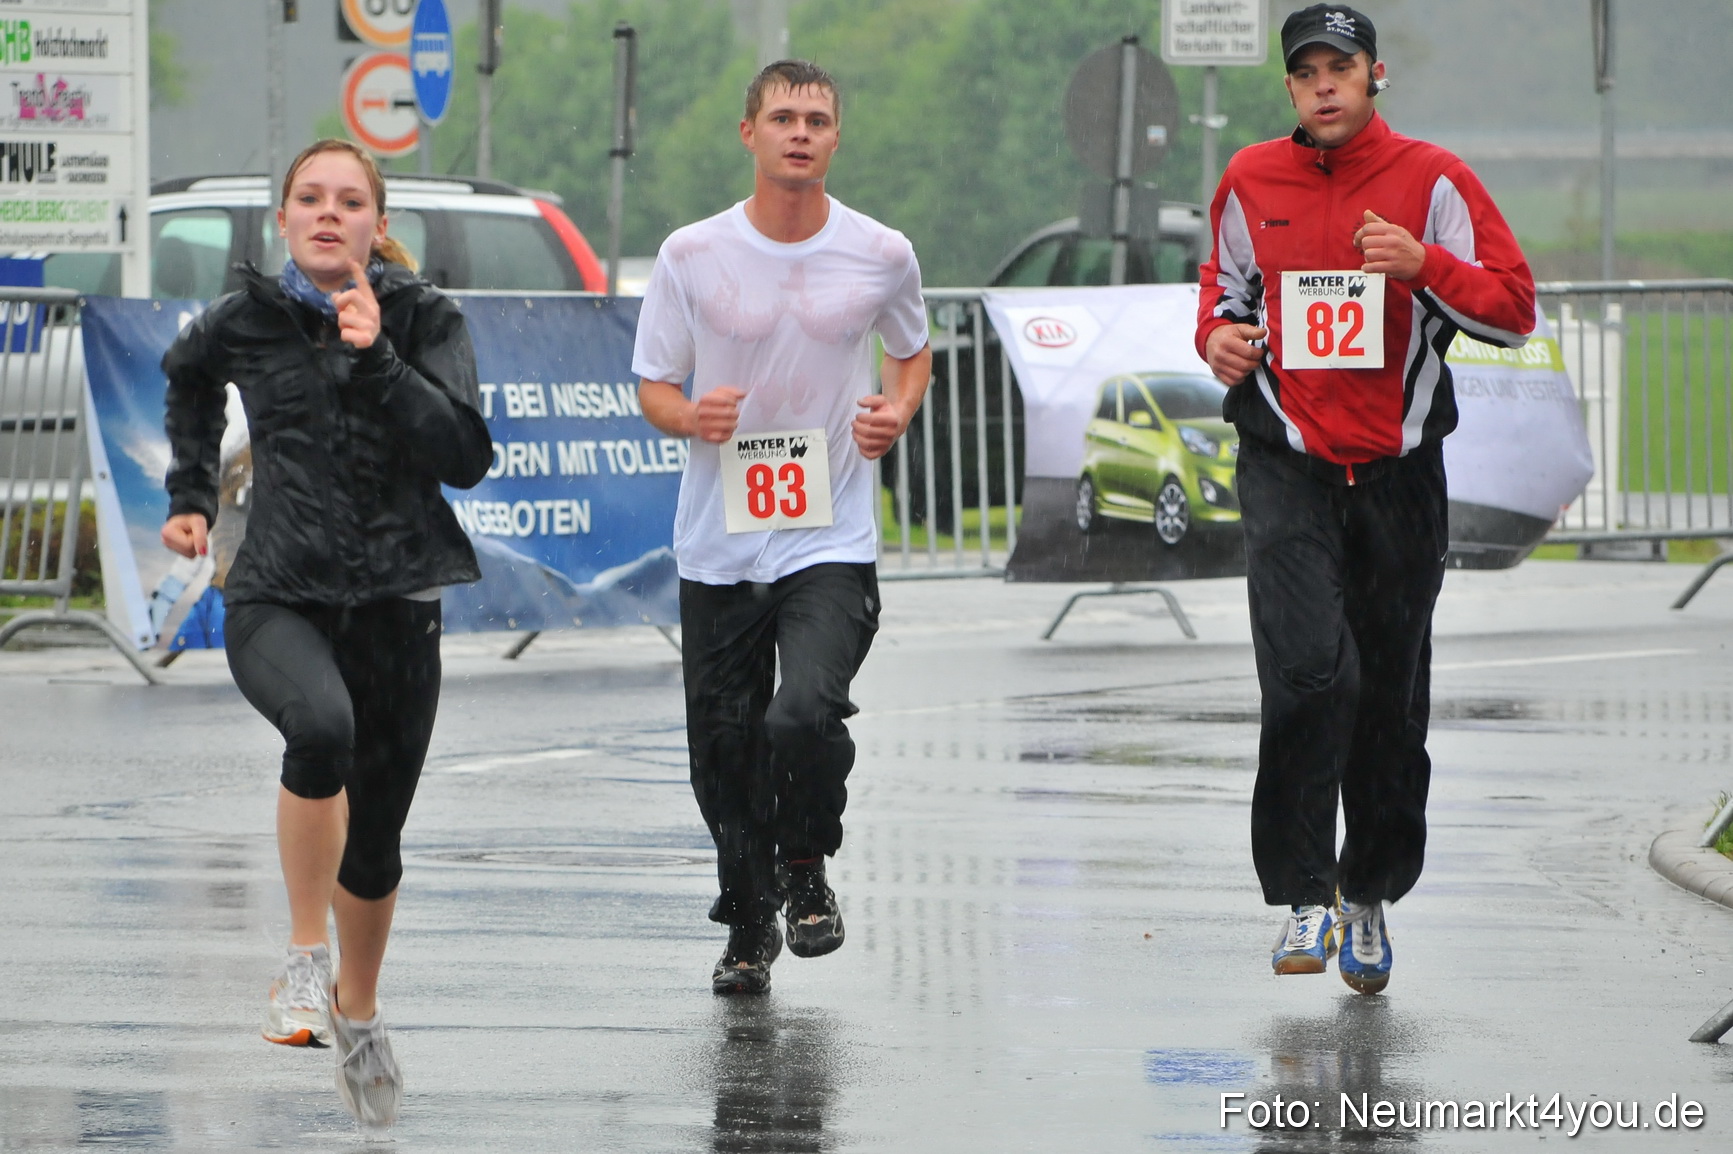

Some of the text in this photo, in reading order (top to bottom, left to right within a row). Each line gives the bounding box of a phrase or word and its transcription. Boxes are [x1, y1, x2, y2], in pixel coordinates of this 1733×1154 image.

[1299, 276, 1345, 287] MEYER
[1299, 287, 1345, 297] WERBUNG
[1032, 324, 1070, 341] KIA
[1306, 301, 1365, 357] 82
[503, 383, 549, 418] BEI
[738, 438, 785, 452] MEYER
[556, 440, 599, 476] MIT
[600, 439, 689, 475] TOLLEN
[738, 449, 787, 460] WERBUNG
[746, 462, 807, 519] 83
